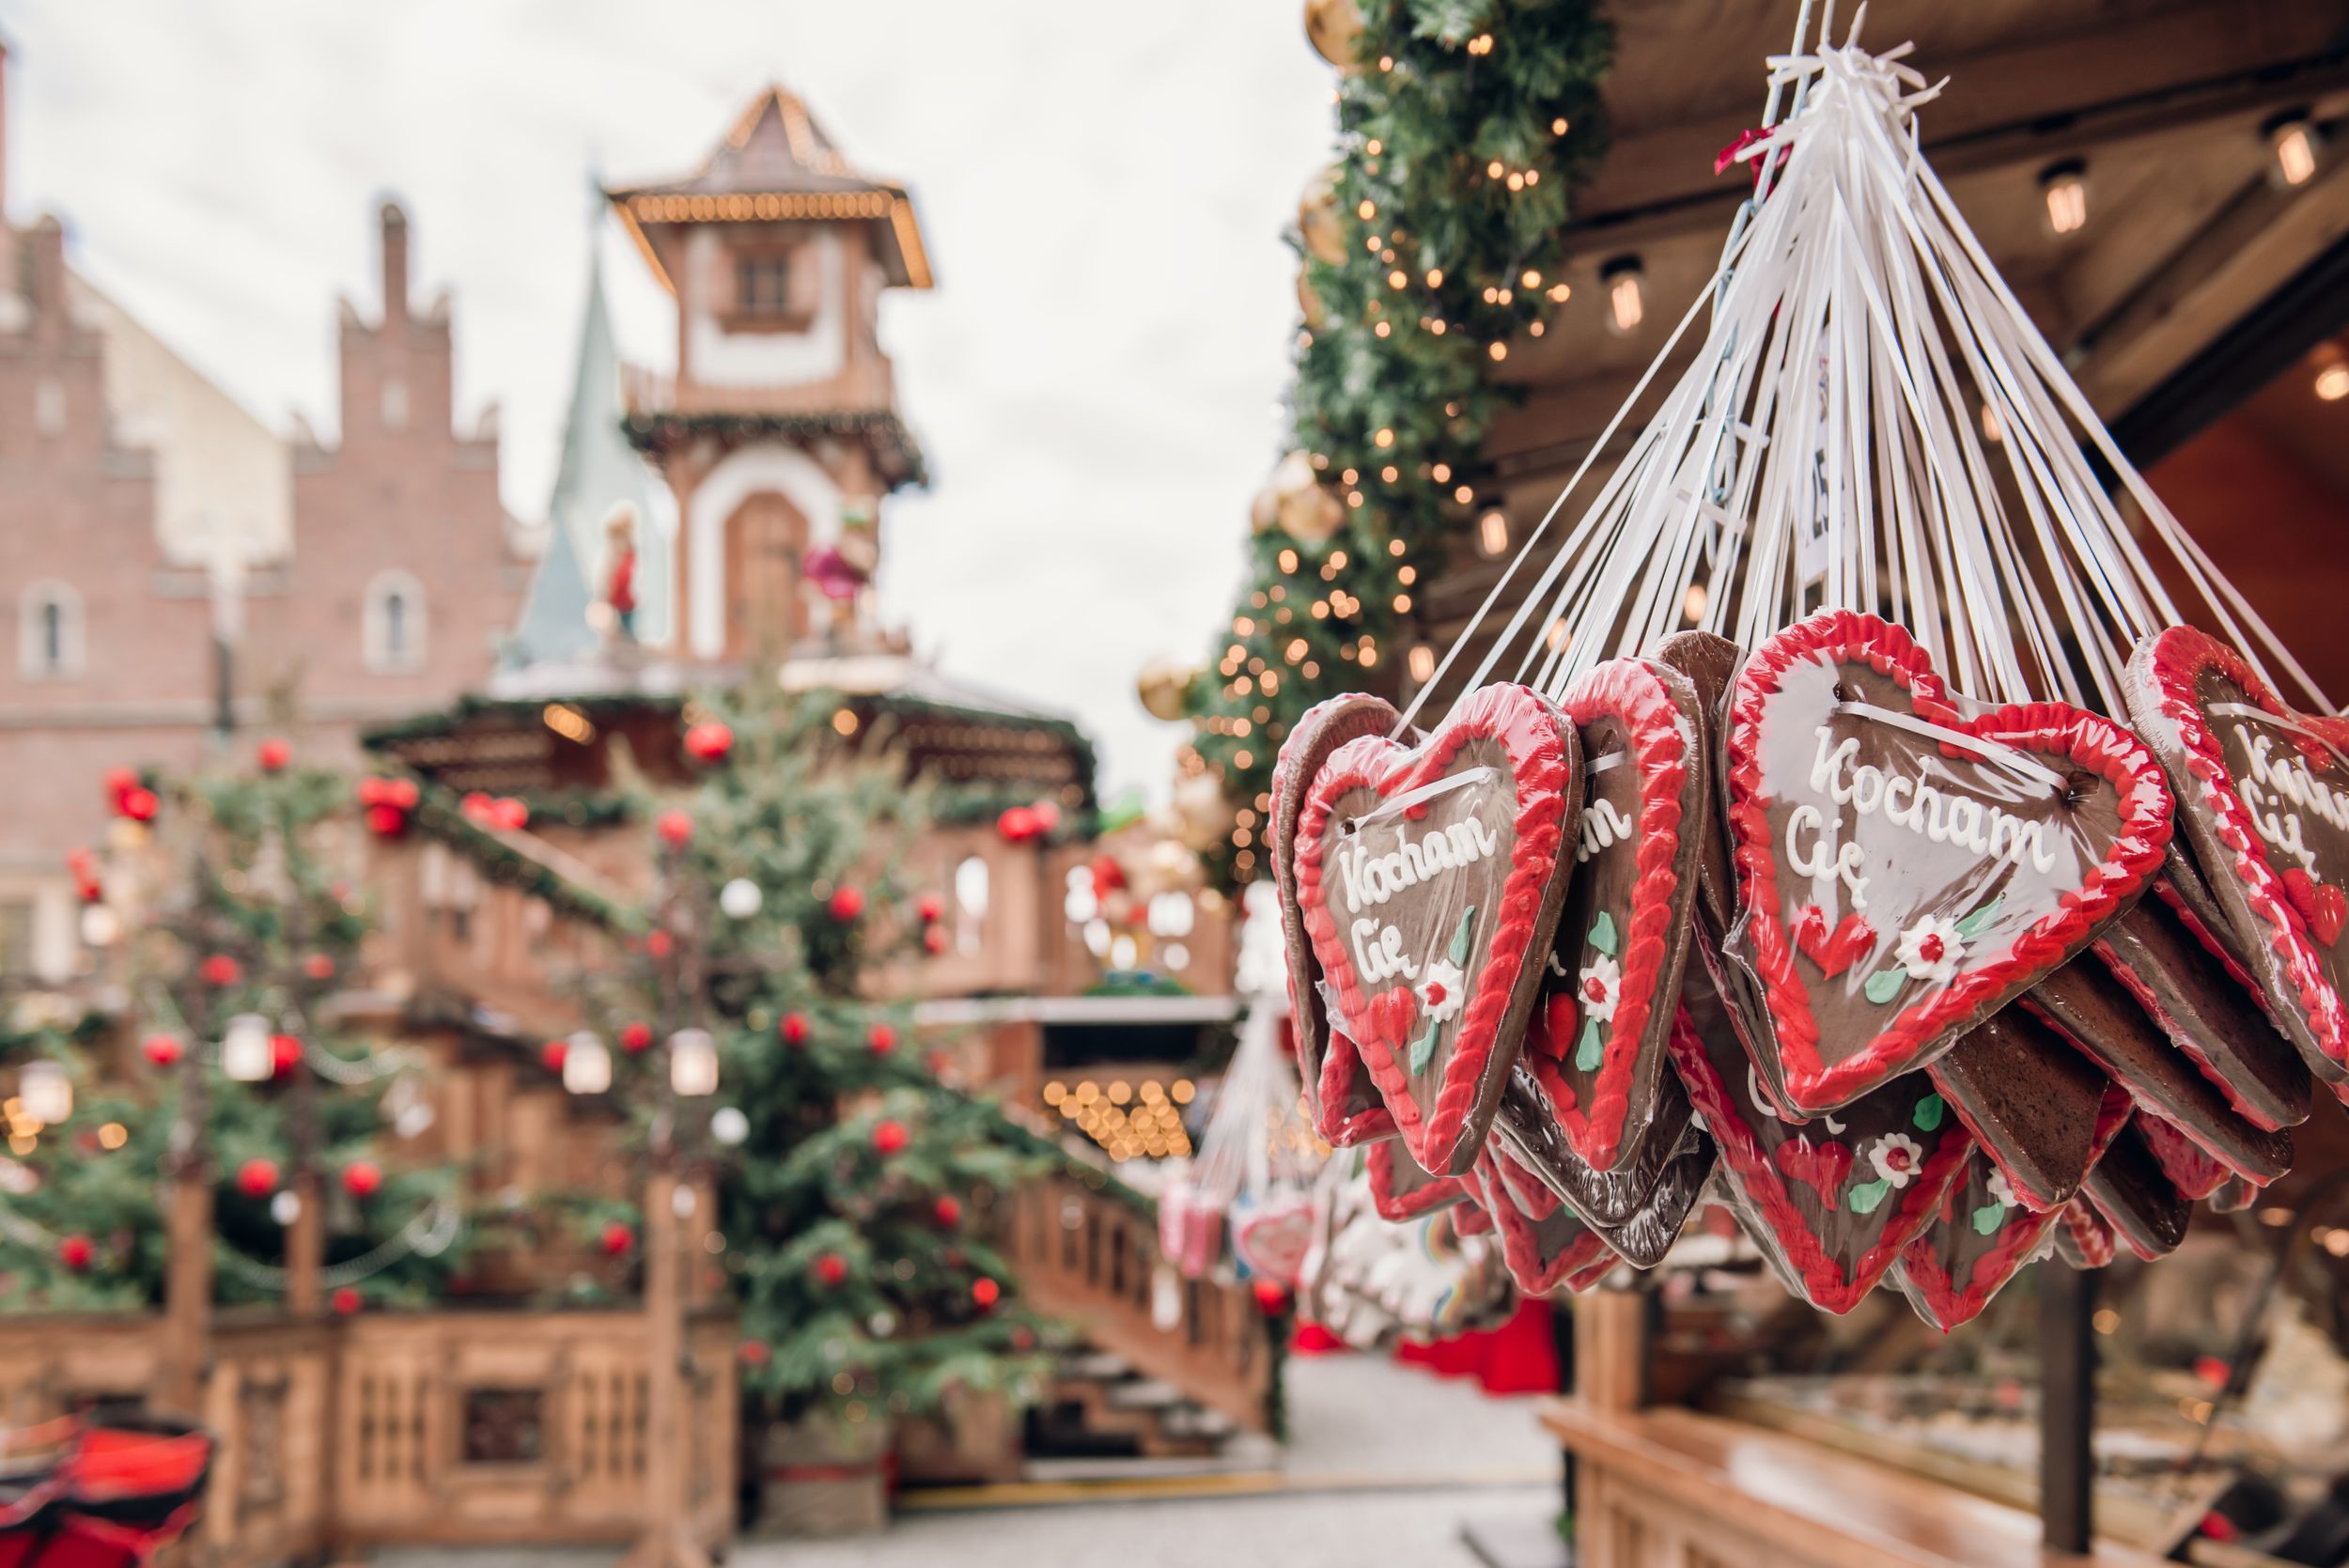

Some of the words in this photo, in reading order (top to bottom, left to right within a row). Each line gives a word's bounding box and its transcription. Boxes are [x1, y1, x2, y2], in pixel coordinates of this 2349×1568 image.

[1810, 726, 2056, 875] Kocham
[1340, 817, 1497, 912] Kocham
[1787, 805, 1867, 908] Cię
